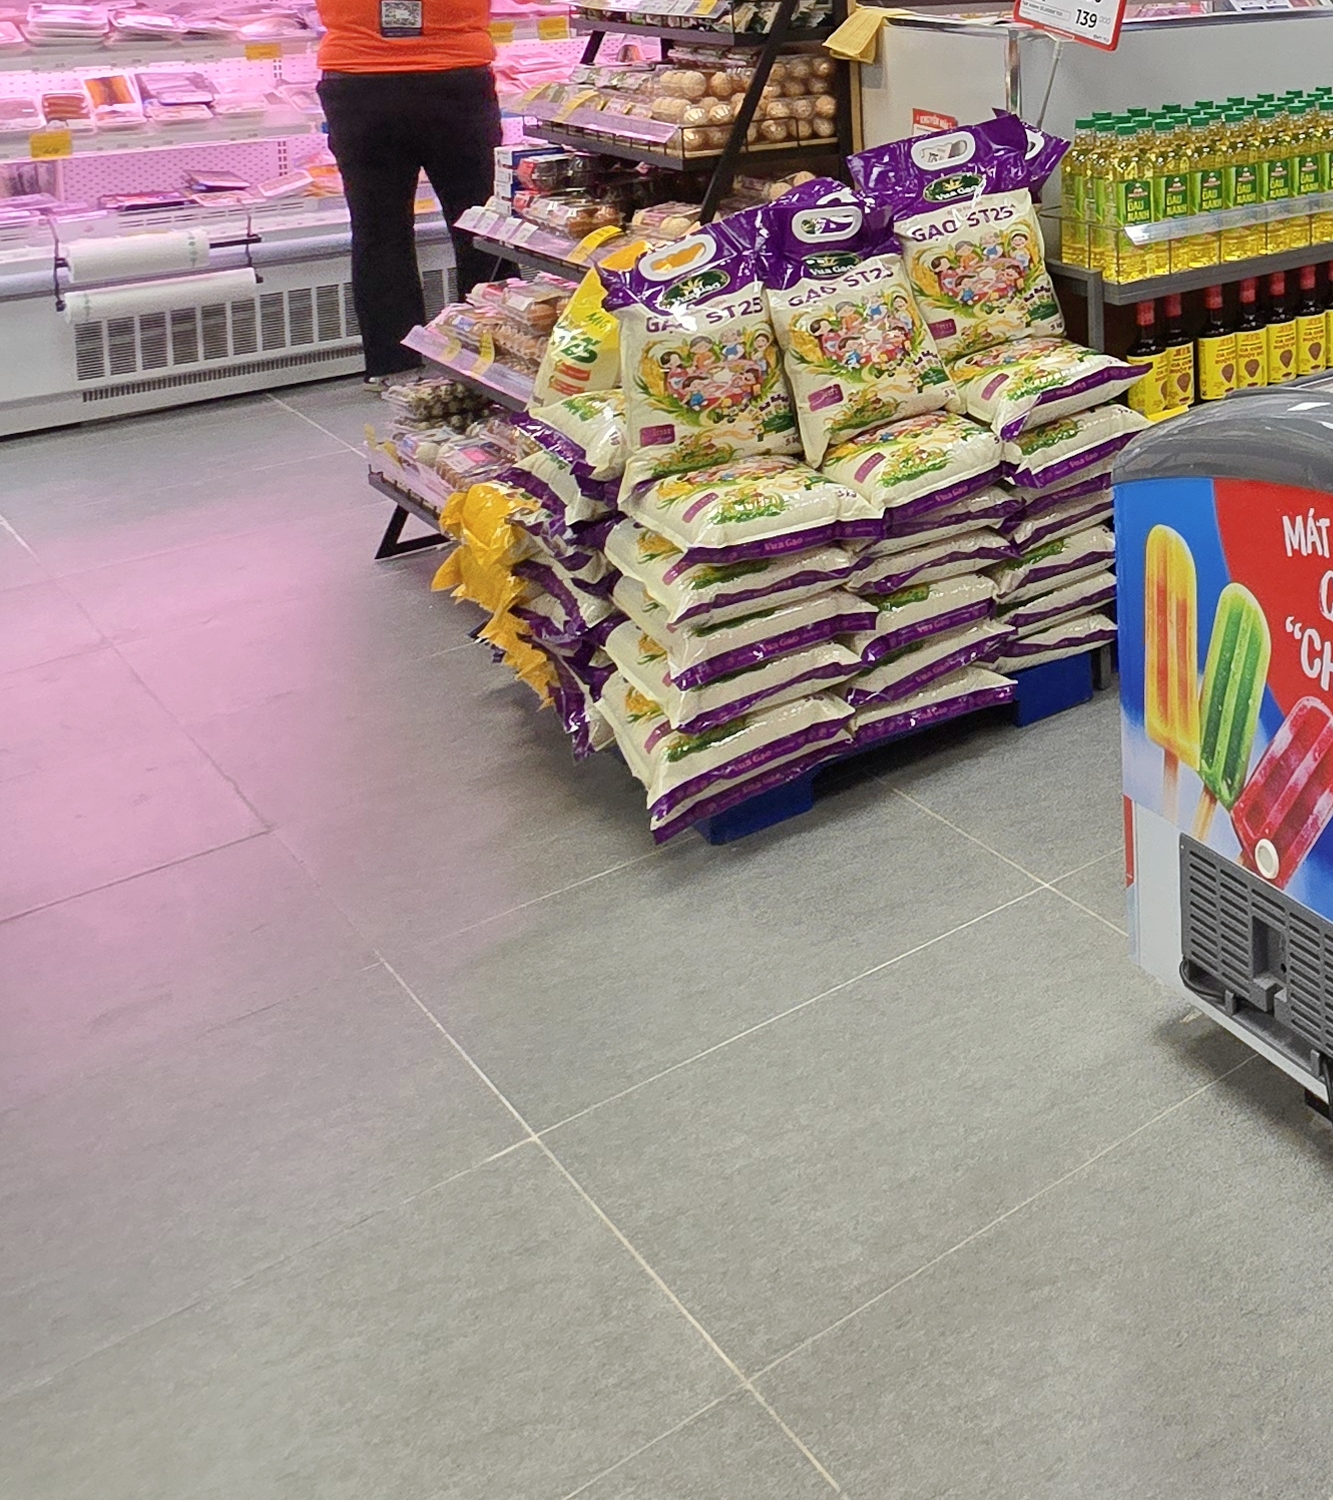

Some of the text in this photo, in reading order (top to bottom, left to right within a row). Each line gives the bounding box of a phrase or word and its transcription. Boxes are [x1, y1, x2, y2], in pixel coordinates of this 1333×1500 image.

[1076, 9, 1098, 28] 139
[706, 298, 763, 324] ST25
[1283, 508, 1331, 558] MÁT
